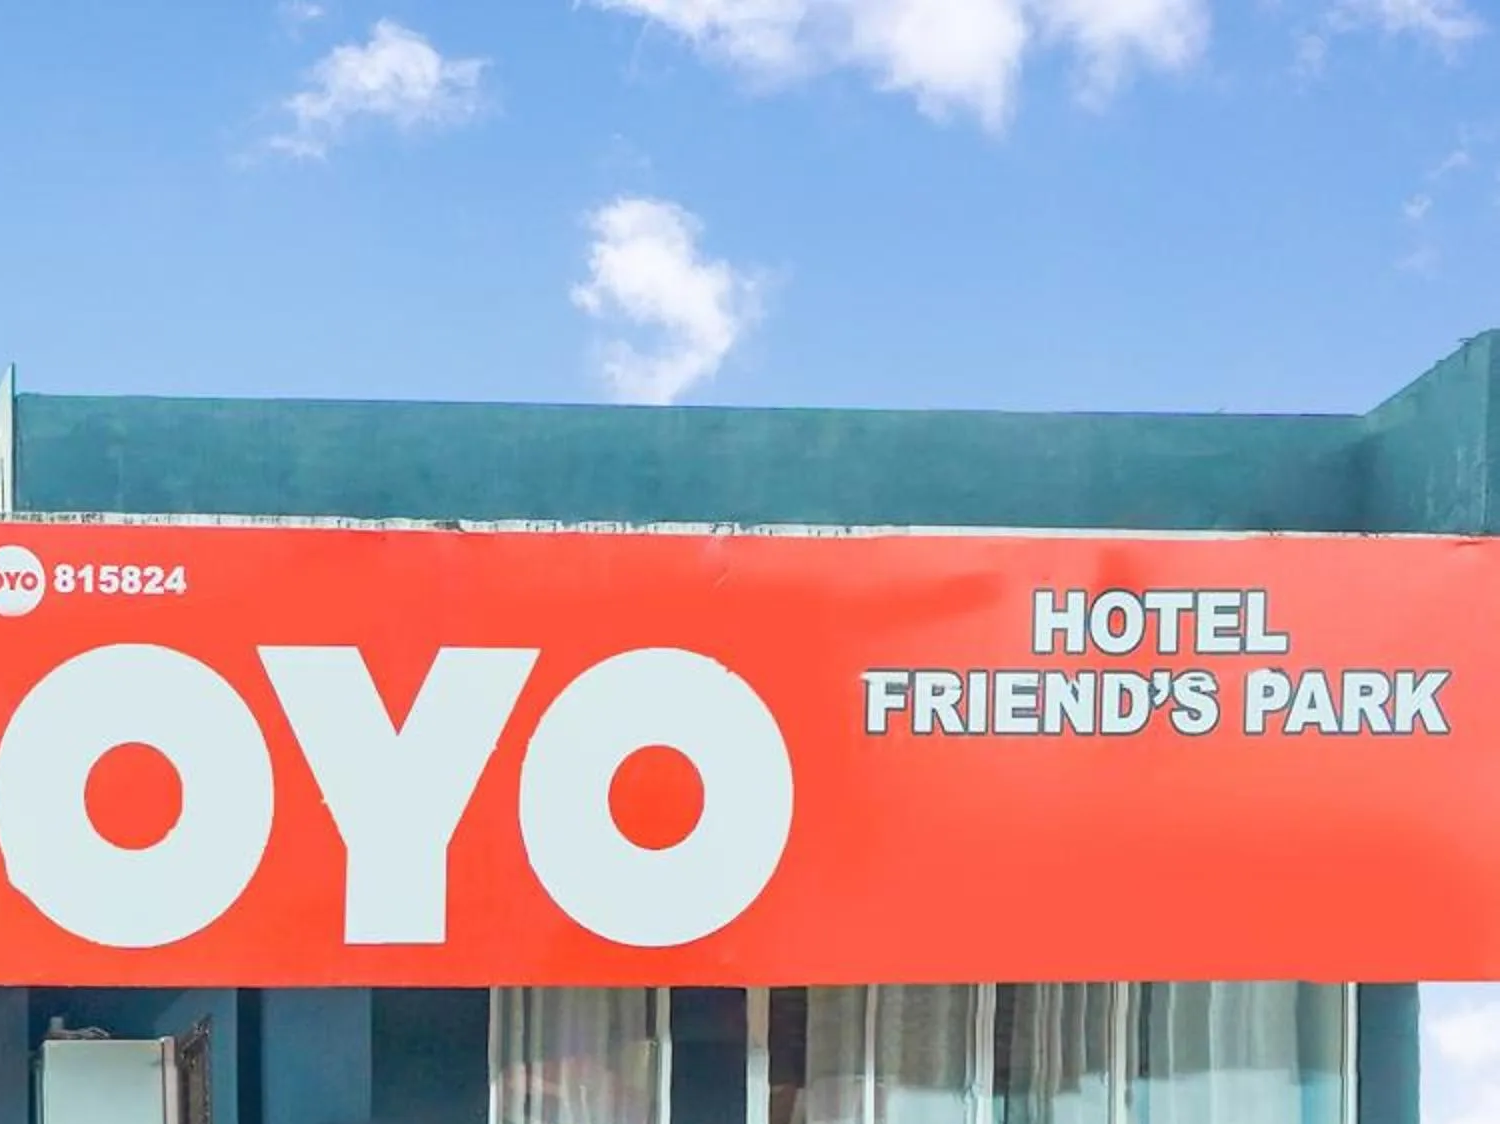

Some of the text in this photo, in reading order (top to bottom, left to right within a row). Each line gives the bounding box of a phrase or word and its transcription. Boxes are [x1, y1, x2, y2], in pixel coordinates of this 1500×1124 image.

[54, 565, 187, 596] 815824
[1032, 588, 1290, 654] HOTEL
[861, 668, 1450, 735] FRIEND'S PARK
